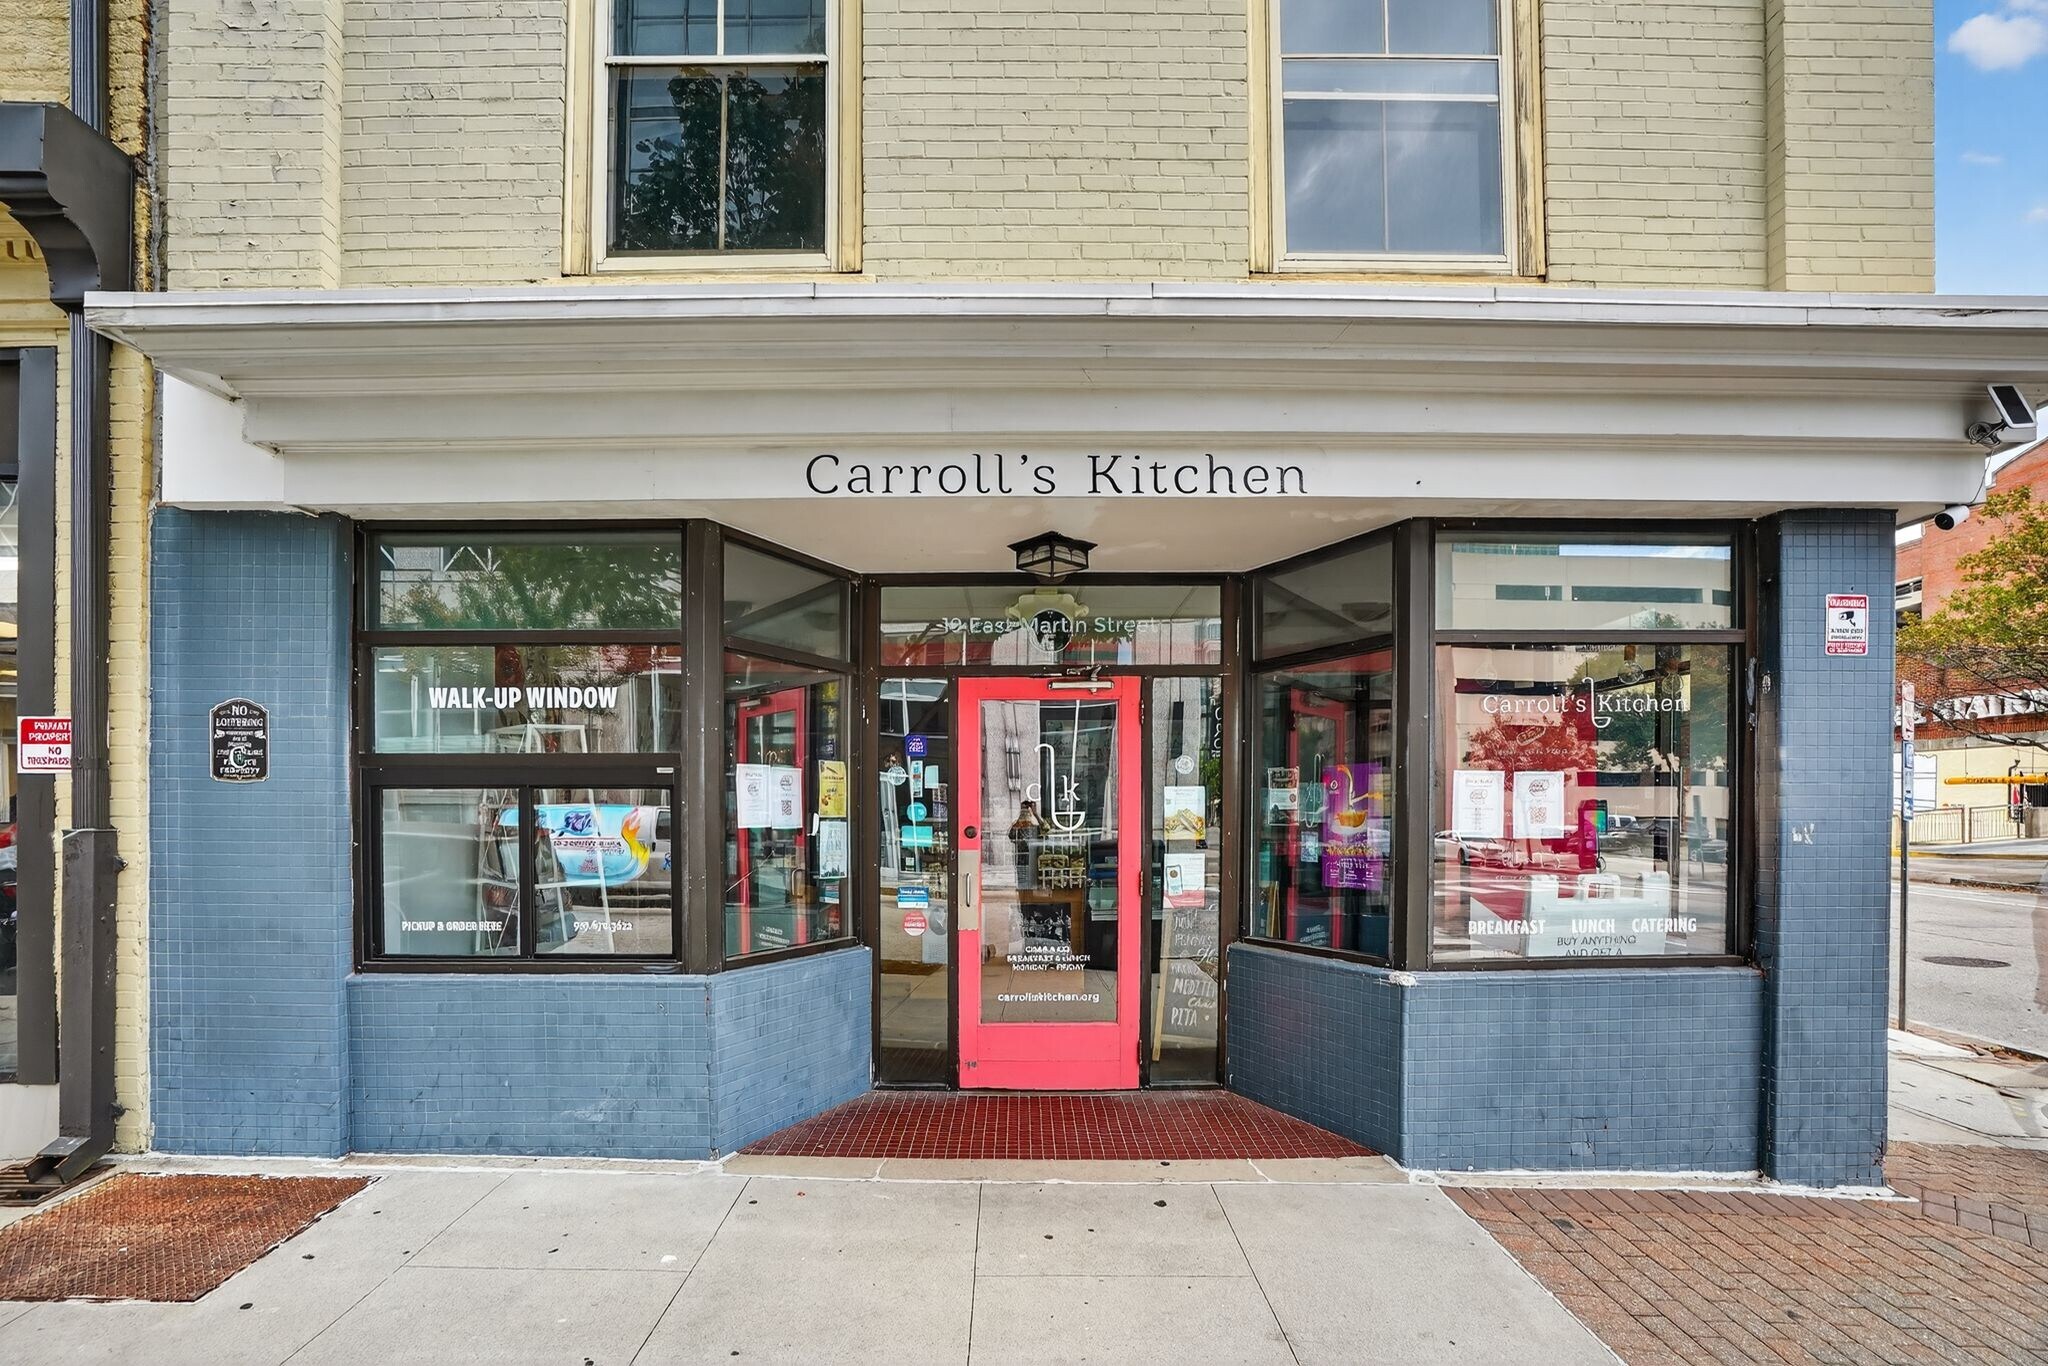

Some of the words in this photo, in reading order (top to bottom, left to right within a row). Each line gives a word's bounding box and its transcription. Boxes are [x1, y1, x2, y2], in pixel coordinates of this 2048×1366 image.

[805, 453, 1057, 495] Carroll's
[1087, 453, 1308, 495] Kitchen
[969, 616, 1013, 634] East
[1020, 616, 1087, 634] Martin
[1094, 616, 1159, 634] Street
[428, 686, 522, 709] WALK-UP
[525, 686, 618, 709] WINDOW
[1482, 693, 1587, 714] Carroll's
[1598, 693, 1689, 713] Kitchen
[231, 705, 248, 716] NO
[48, 746, 62, 756] NO
[401, 920, 435, 932] PICKUP
[1468, 919, 1546, 936] BREAKFAST
[1571, 918, 1616, 934] LUNCH
[1631, 917, 1697, 934] CATERING
[1557, 936, 1578, 946] BUY
[1580, 934, 1637, 945] ANYTHING
[1171, 1007, 1198, 1027] PITA
